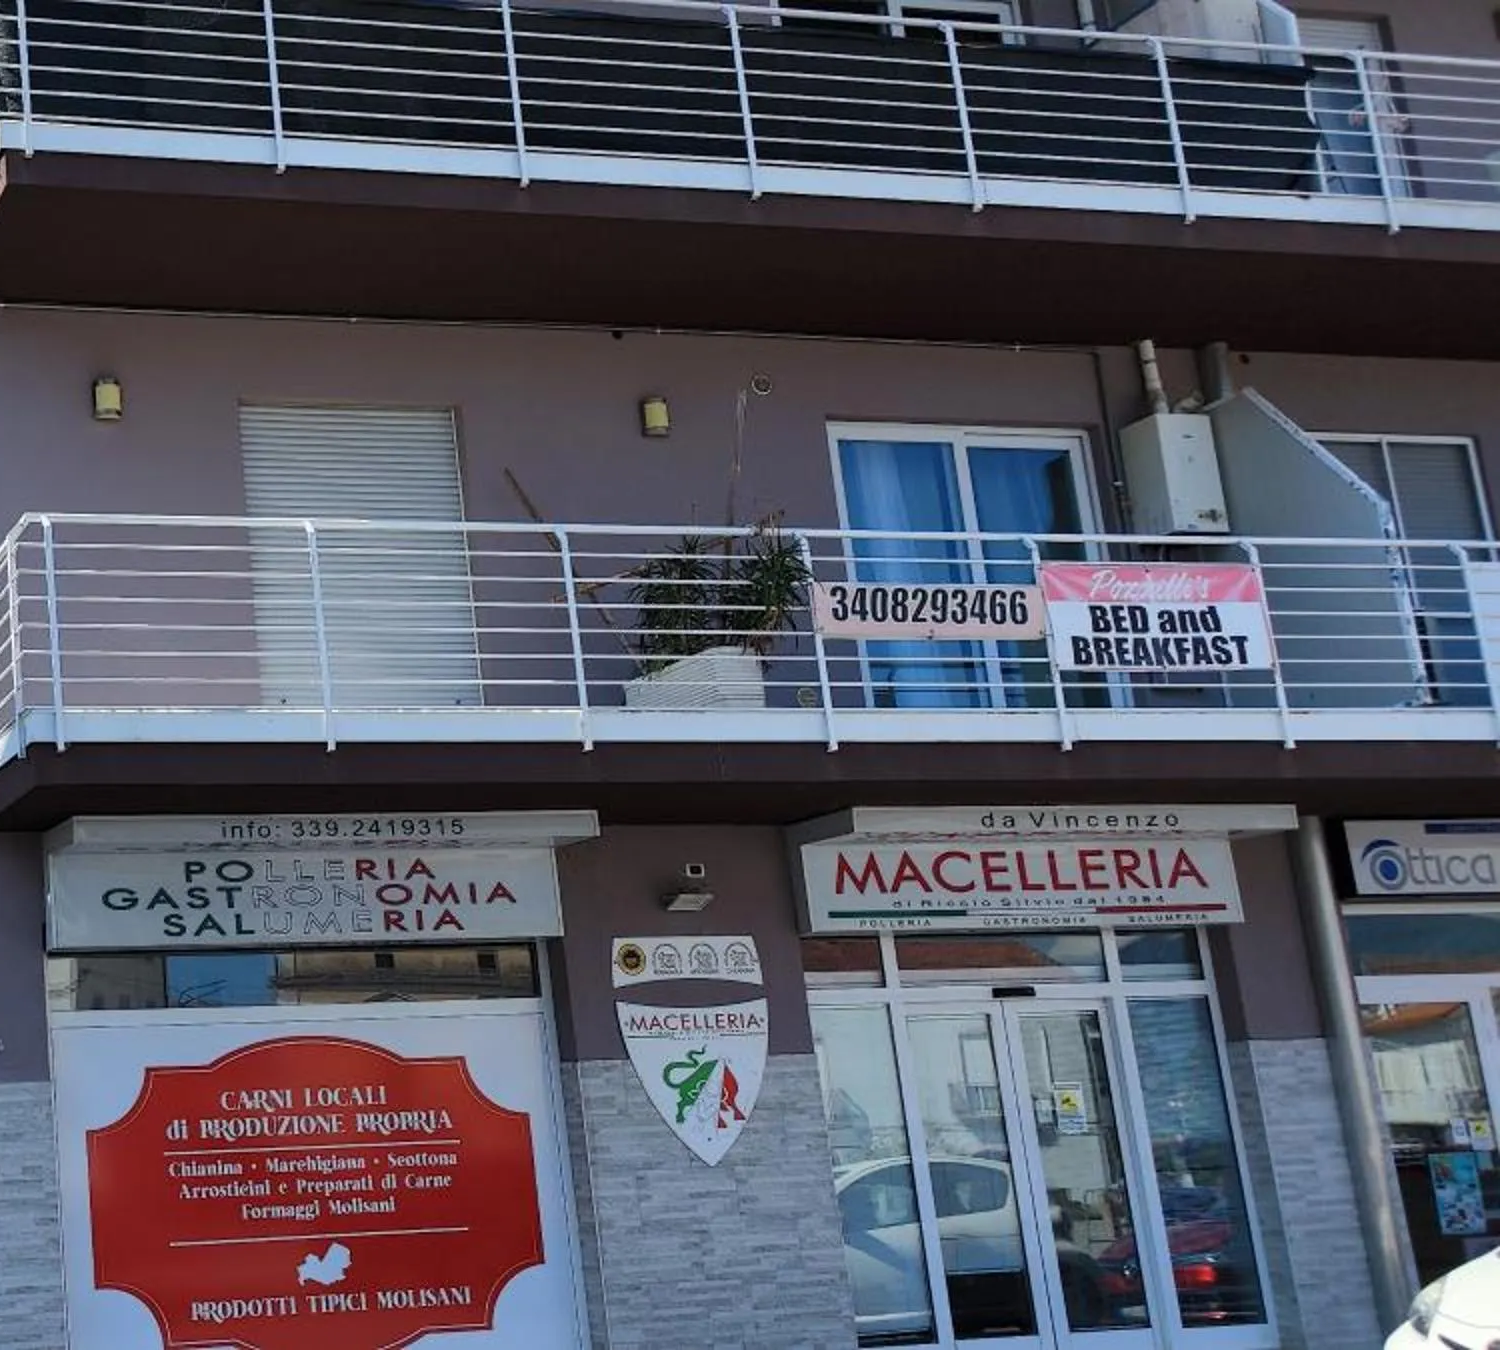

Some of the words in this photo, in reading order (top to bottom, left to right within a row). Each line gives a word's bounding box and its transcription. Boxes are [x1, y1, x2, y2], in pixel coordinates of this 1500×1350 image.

[830, 586, 1029, 624] 3408293466
[1089, 605, 1149, 633] BED
[1158, 605, 1223, 633] and
[1071, 636, 1248, 666] BREAKFAST
[221, 820, 281, 838] info:
[291, 818, 466, 838] 339.2419315
[981, 812, 1016, 828] da
[1029, 810, 1180, 829] Vincenzo
[184, 858, 436, 883] POLLERIA
[835, 847, 1209, 894] MACELLERIA
[101, 882, 517, 911] GASTRONOMIA
[163, 908, 466, 937] SALUMERIA
[629, 1013, 760, 1031] MACELLERIA
[220, 1089, 293, 1112] CARNI
[304, 1086, 388, 1107] LOCALI
[166, 1119, 189, 1140] di
[199, 1113, 345, 1142] PRODUZIONE
[355, 1109, 453, 1135] PROPRIA
[169, 1161, 243, 1177] Chianina
[296, 1174, 373, 1197] Preparati
[381, 1173, 397, 1190] di
[405, 1173, 453, 1189] Carne
[242, 1199, 319, 1221] Formaggi
[328, 1195, 396, 1215] Molisani
[191, 1295, 298, 1324] PRODOTTI
[306, 1292, 368, 1313] TIPICI
[377, 1285, 472, 1309] MOLISANI
